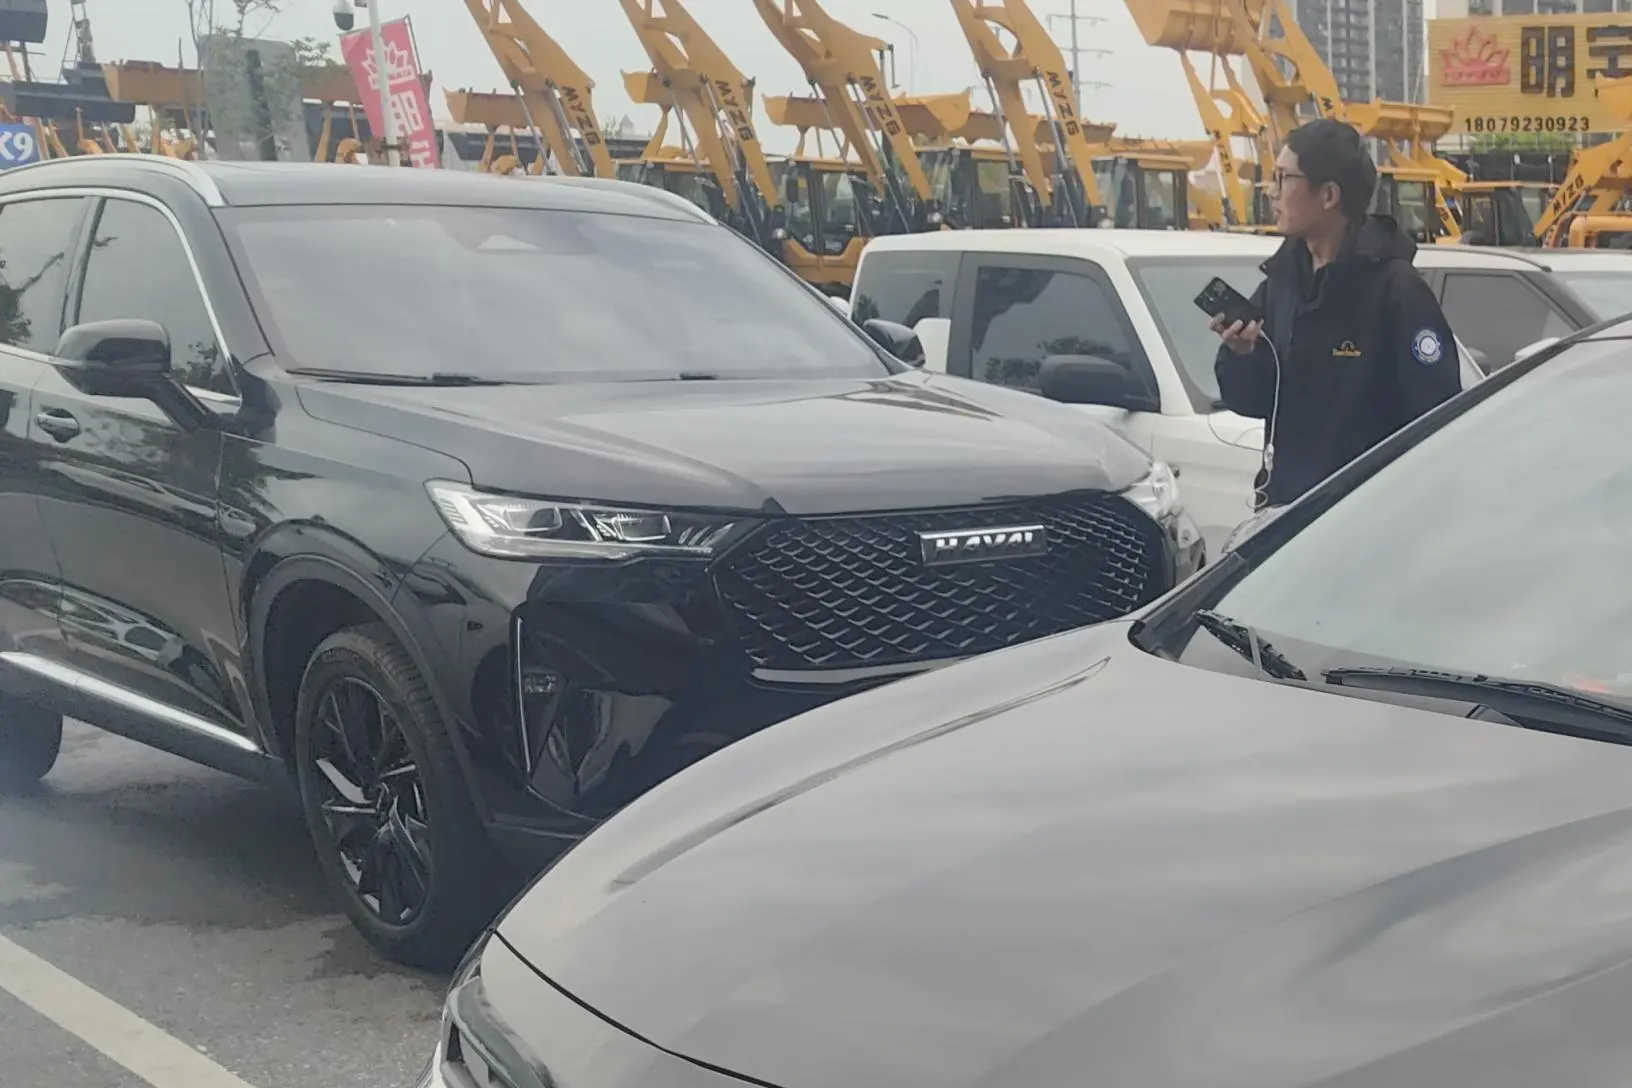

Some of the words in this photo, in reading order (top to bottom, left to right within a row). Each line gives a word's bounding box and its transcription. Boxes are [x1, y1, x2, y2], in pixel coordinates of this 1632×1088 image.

[562, 85, 601, 146] MYZG
[714, 79, 754, 141] MYZG
[859, 75, 901, 137] MYZG
[1045, 69, 1080, 137] MYZG
[1464, 115, 1591, 133] 18079230923
